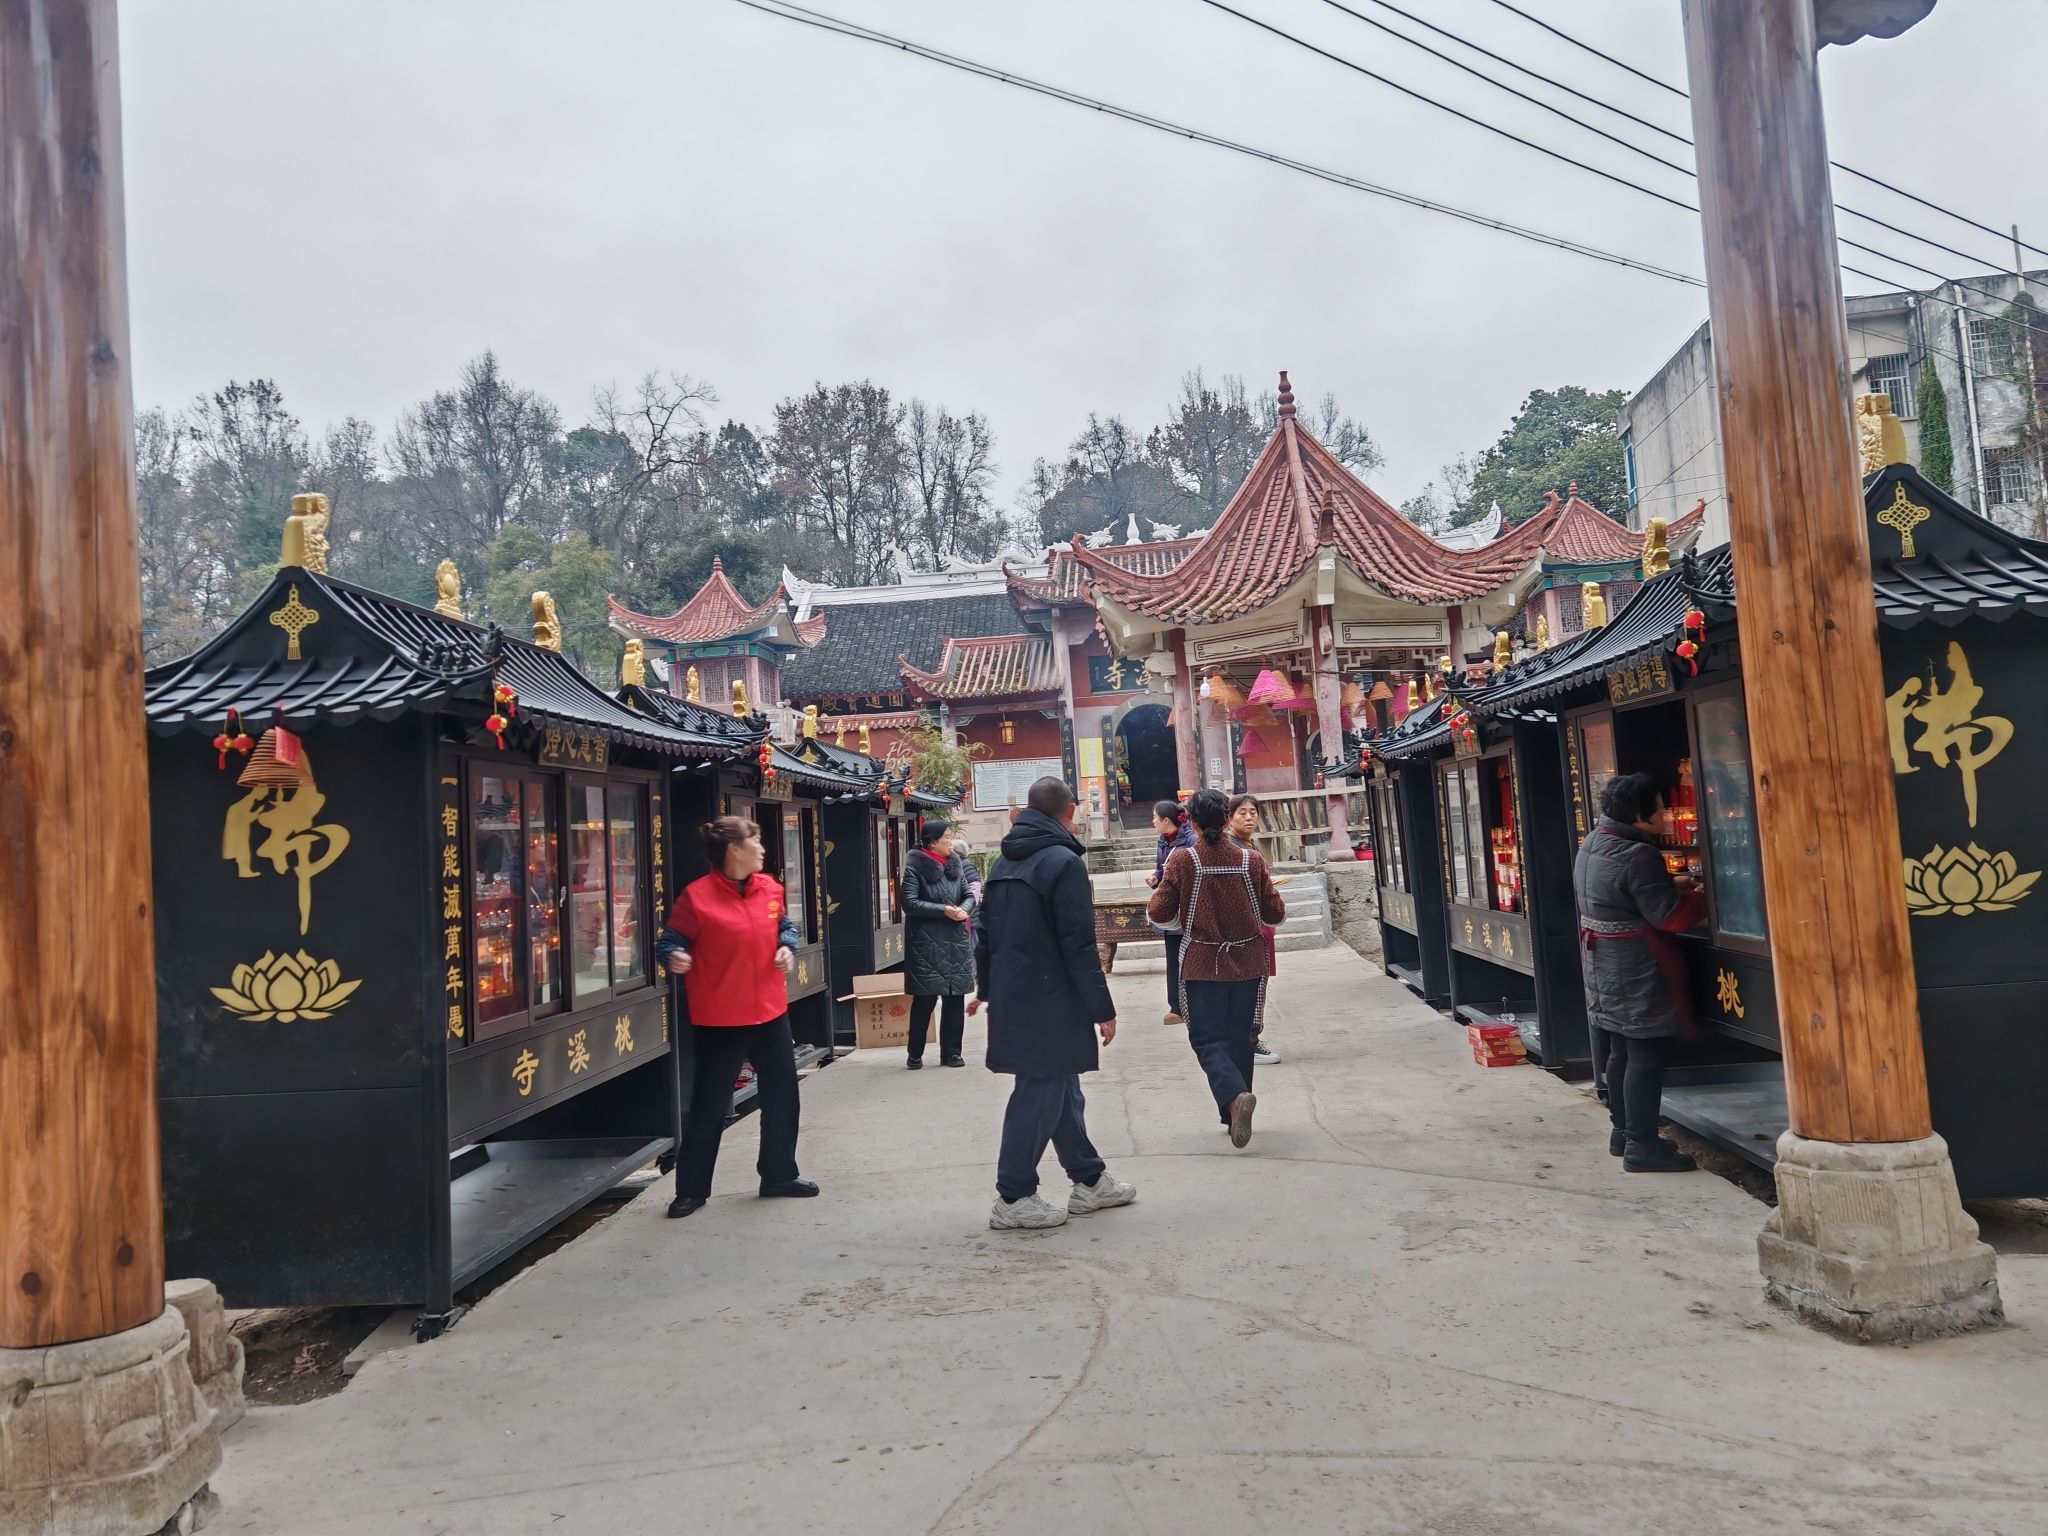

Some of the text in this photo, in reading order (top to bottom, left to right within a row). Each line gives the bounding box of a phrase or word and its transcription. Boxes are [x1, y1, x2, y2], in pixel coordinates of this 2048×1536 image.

[441, 777, 465, 1040] 一智能滅萬年愚
[512, 1015, 634, 1097] 桃溪寺
